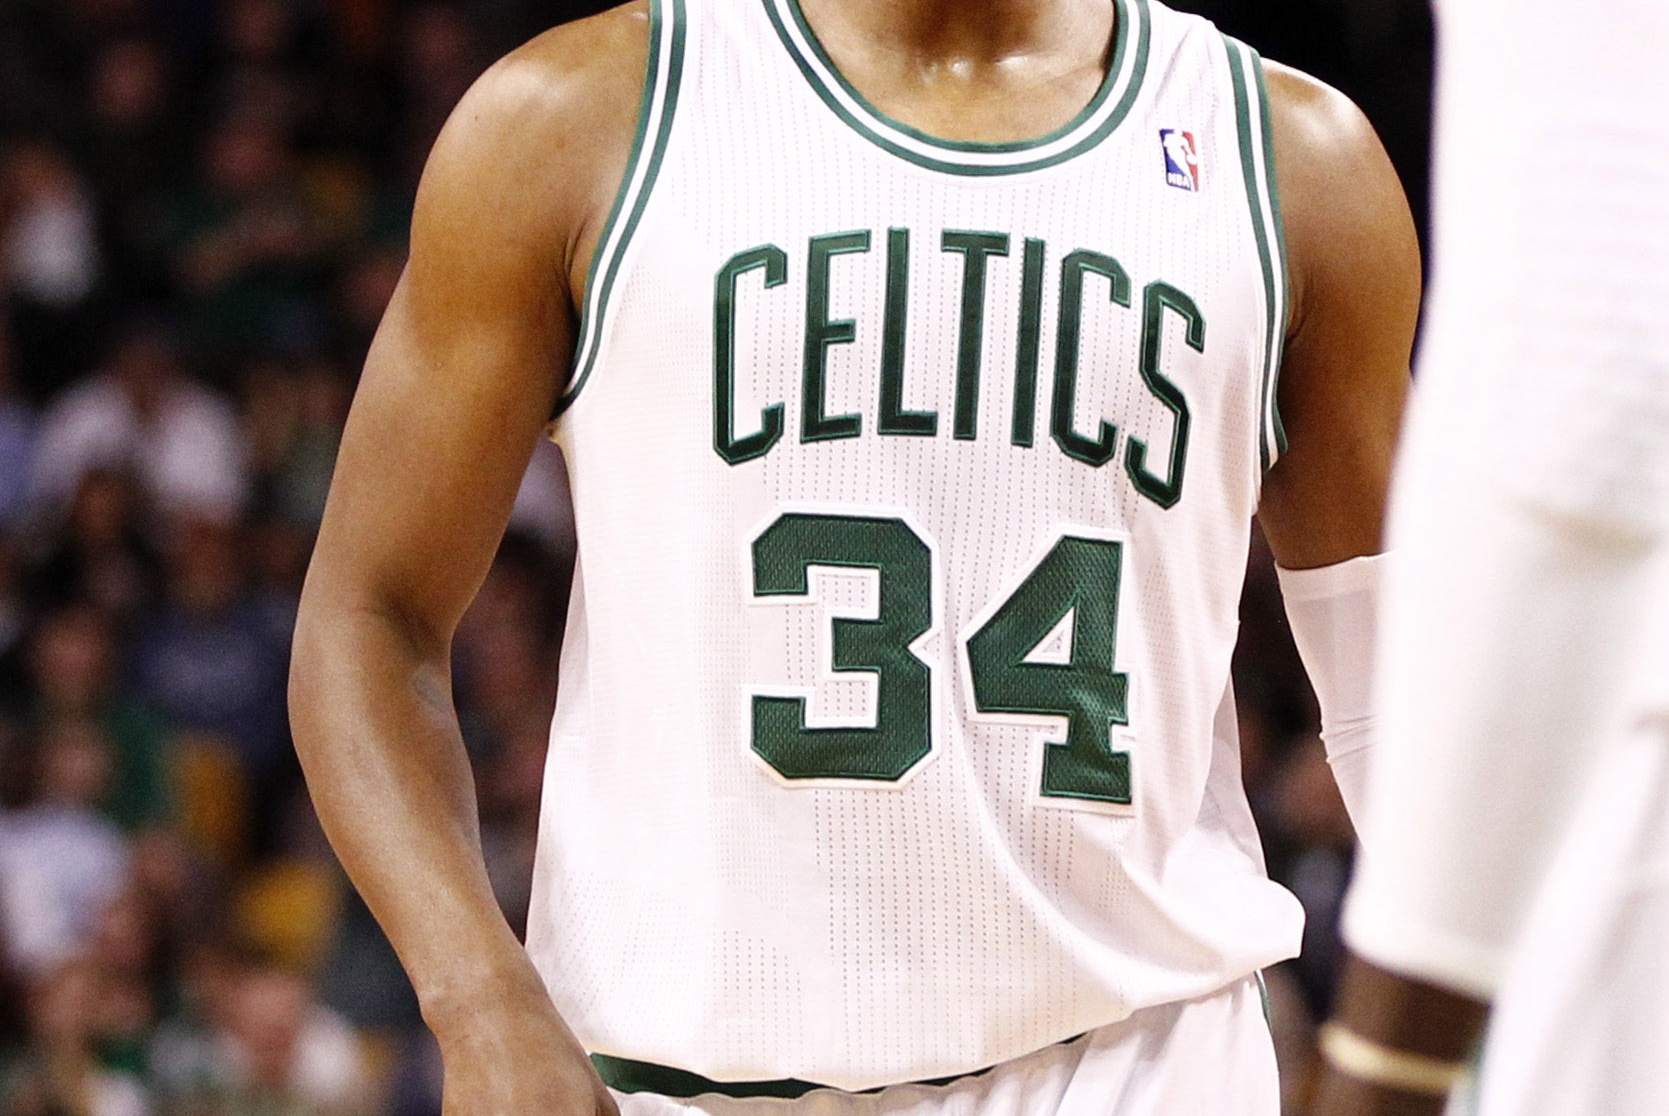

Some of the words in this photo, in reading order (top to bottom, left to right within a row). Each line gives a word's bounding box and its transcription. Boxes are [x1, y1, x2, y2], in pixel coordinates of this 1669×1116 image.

[1168, 172, 1190, 188] NBA
[712, 226, 1206, 510] CELTICS
[750, 510, 1133, 806] 34
